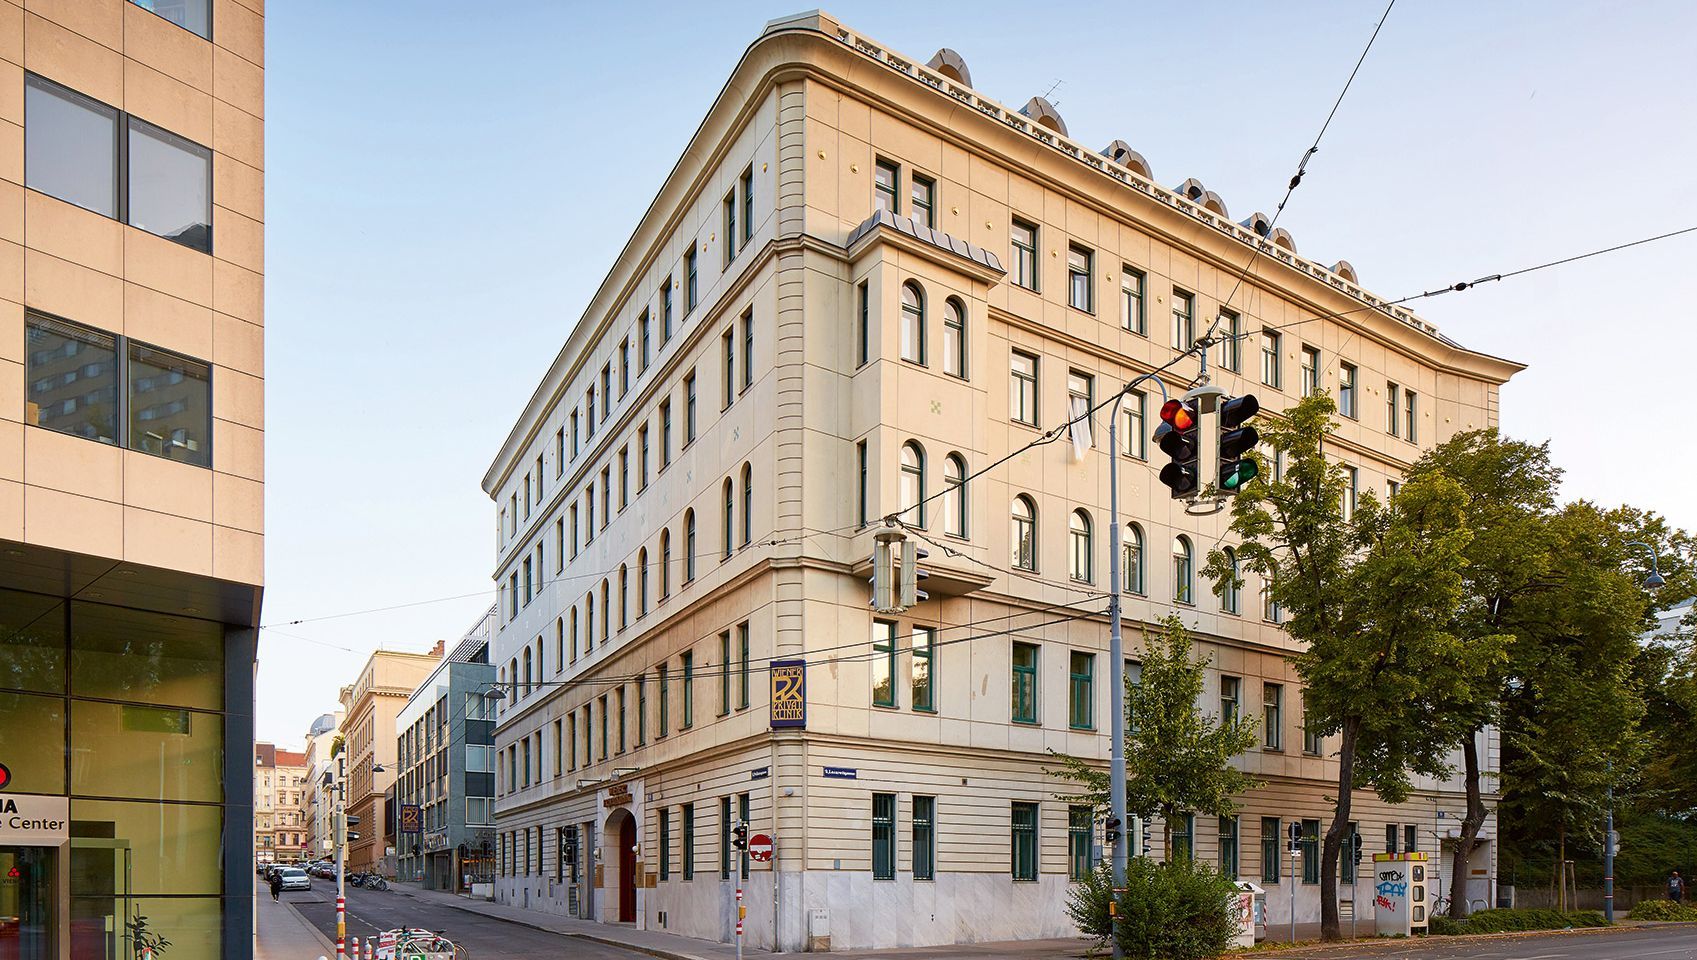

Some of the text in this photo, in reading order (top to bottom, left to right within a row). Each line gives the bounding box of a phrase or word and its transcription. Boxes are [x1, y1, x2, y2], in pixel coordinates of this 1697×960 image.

[772, 668, 802, 676] WIENER
[773, 700, 803, 709] PRIVAT
[772, 709, 803, 719] KLINIK
[9, 816, 65, 830] Center
